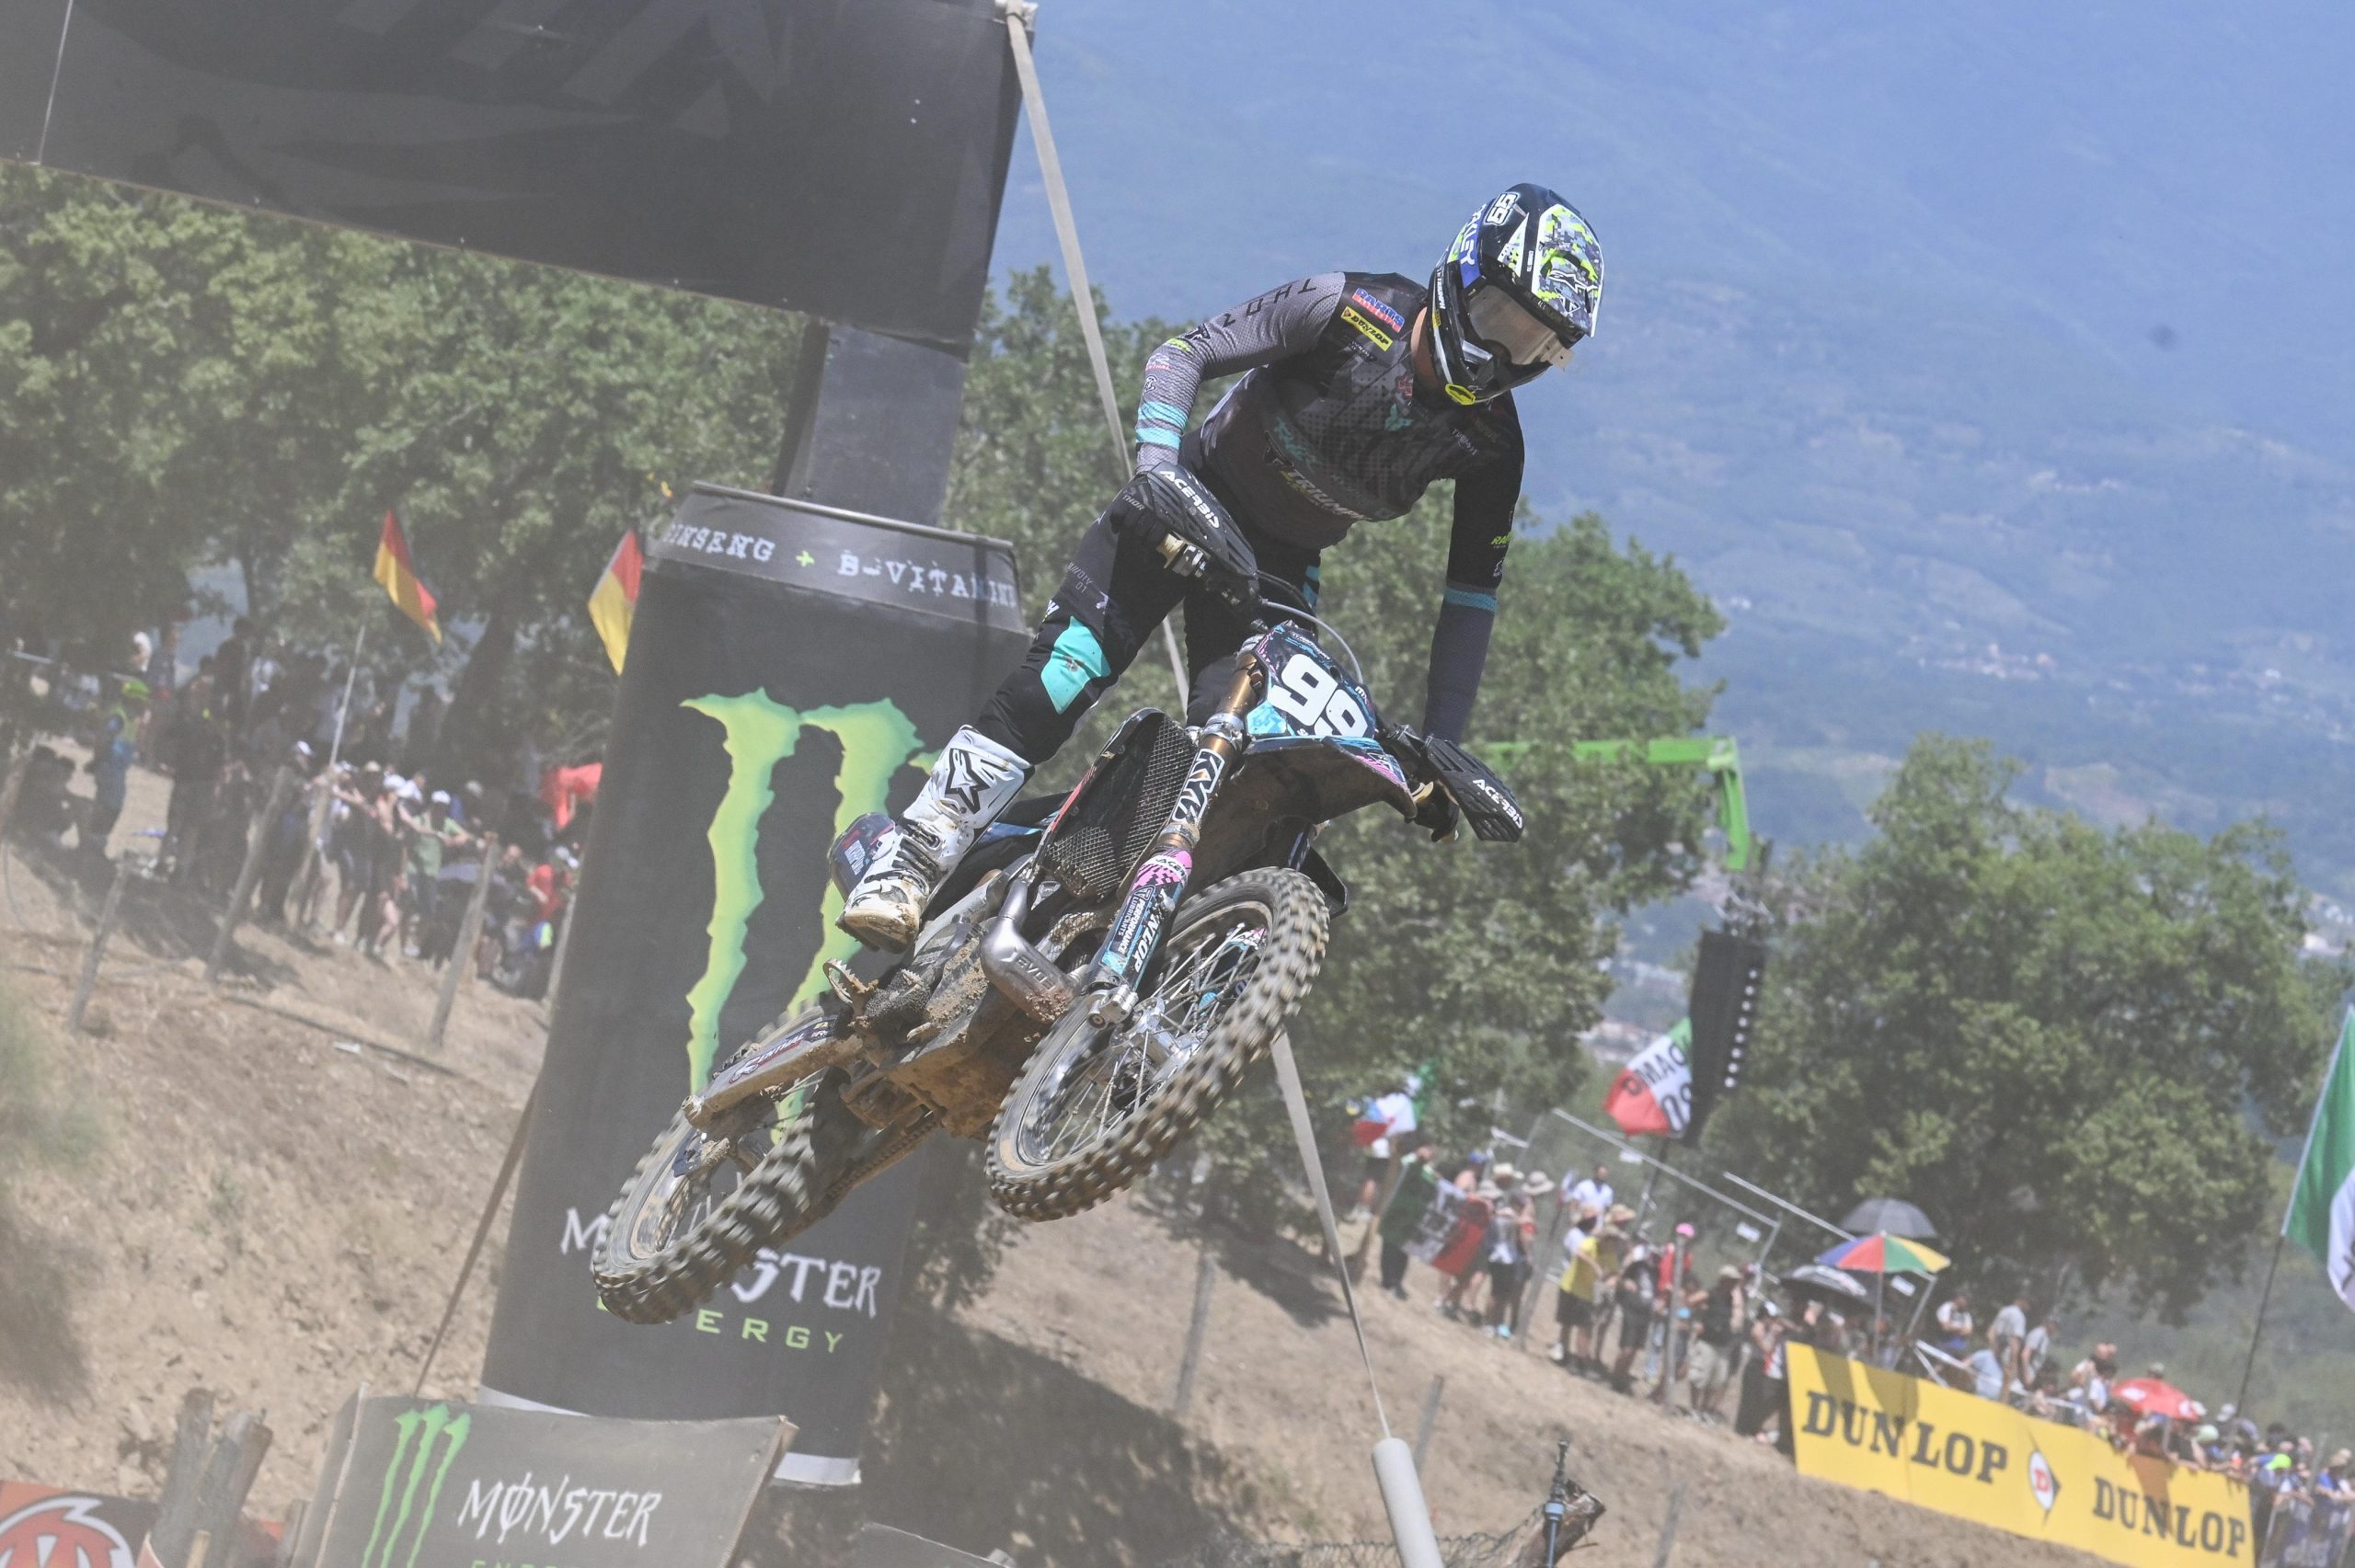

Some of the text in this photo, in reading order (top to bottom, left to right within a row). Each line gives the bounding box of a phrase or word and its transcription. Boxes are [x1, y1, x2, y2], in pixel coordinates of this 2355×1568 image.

[1350, 315, 1390, 345] DUNLOP
[1122, 494, 1145, 511] THOR
[662, 523, 775, 562] INSENG
[1267, 654, 1369, 738] 99
[1117, 896, 1139, 936] LUBRICANTS
[1118, 898, 1145, 955] PERFORMANCE
[1132, 913, 1159, 973] NLOP
[560, 1207, 881, 1319] MSTER
[1801, 1390, 2008, 1484] DUNLOP
[2091, 1476, 2246, 1559] DUNLOP
